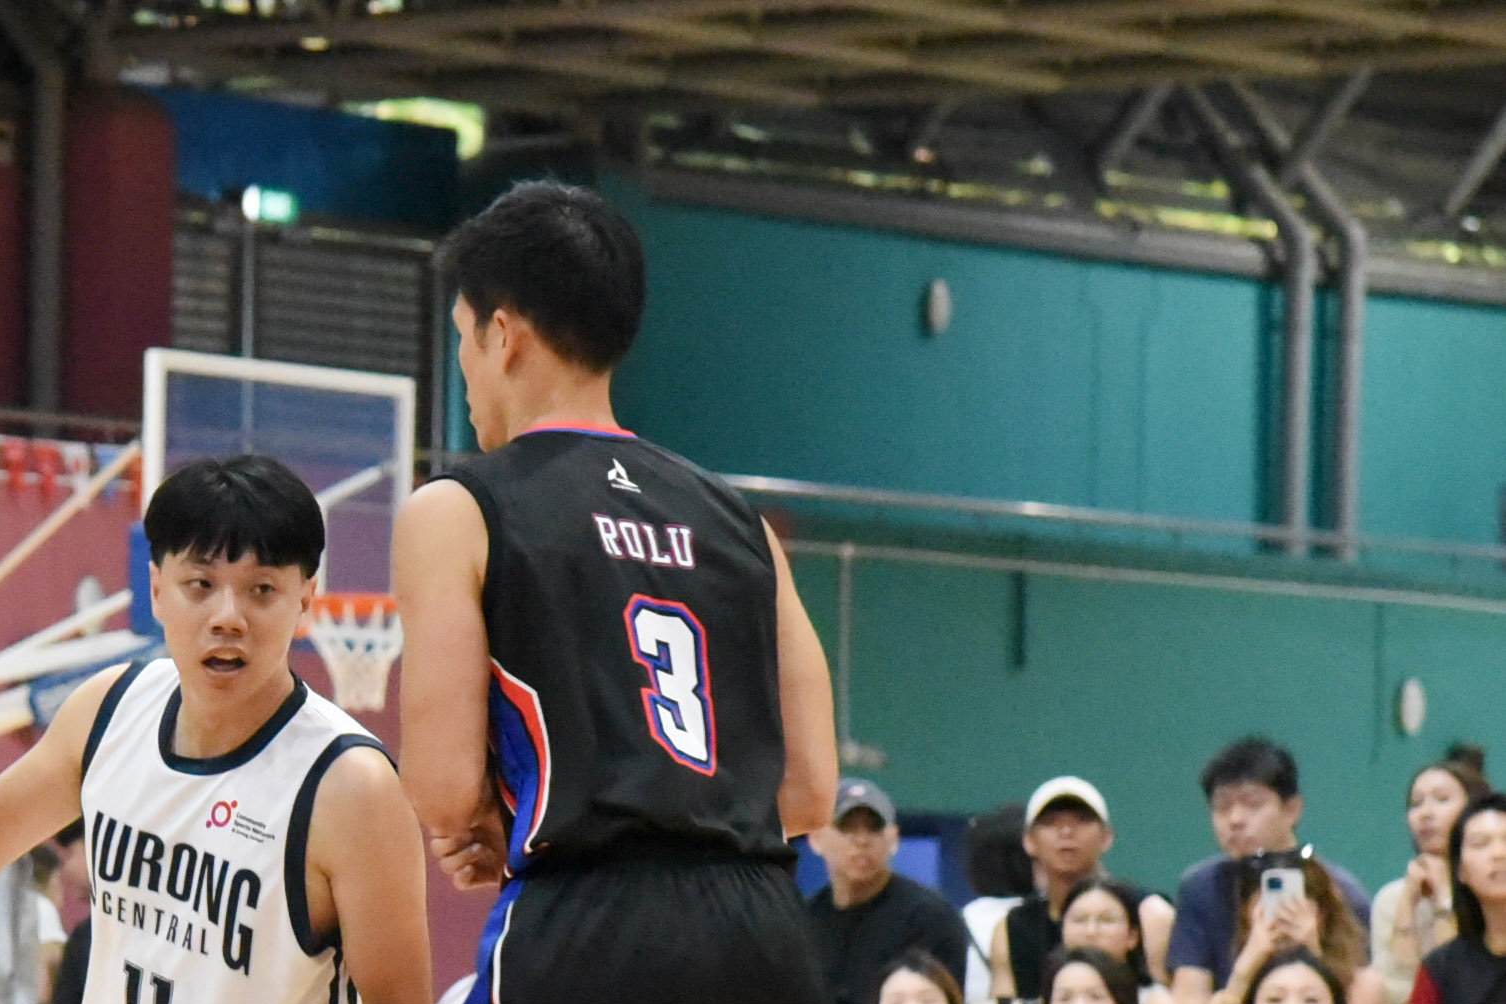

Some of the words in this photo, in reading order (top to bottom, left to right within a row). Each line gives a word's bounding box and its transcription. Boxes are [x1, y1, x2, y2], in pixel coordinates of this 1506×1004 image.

[592, 512, 696, 569] ROLU
[624, 594, 716, 776] 3
[102, 890, 209, 956] CENTRAL
